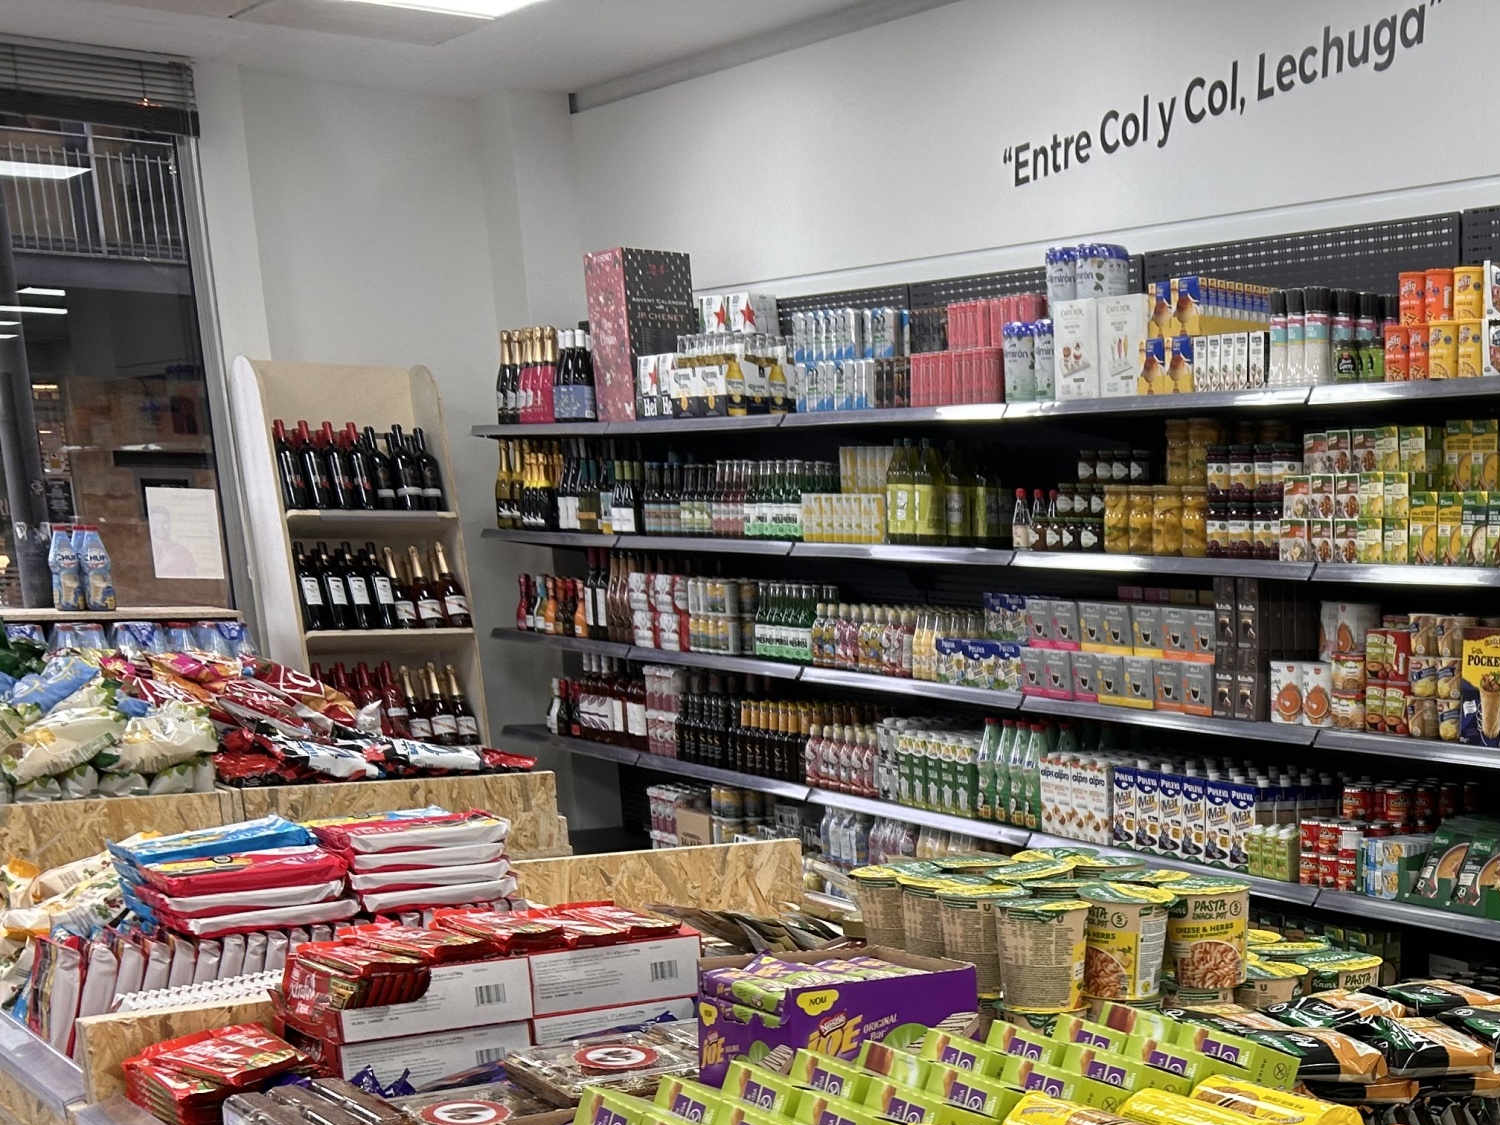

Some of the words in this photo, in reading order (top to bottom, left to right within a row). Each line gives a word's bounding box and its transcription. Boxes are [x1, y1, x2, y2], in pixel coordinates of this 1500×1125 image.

[1003, 130, 1092, 187] “Entre
[1100, 102, 1149, 156] Col
[1157, 96, 1177, 149] y
[1184, 60, 1247, 124] Col,
[1087, 905, 1108, 920] ASTA
[1193, 899, 1227, 913] PASTA
[1175, 926, 1201, 934] CHEESE
[1209, 922, 1234, 931] HERBS
[1311, 978, 1338, 989] Knorr
[1344, 972, 1371, 986] PASTA
